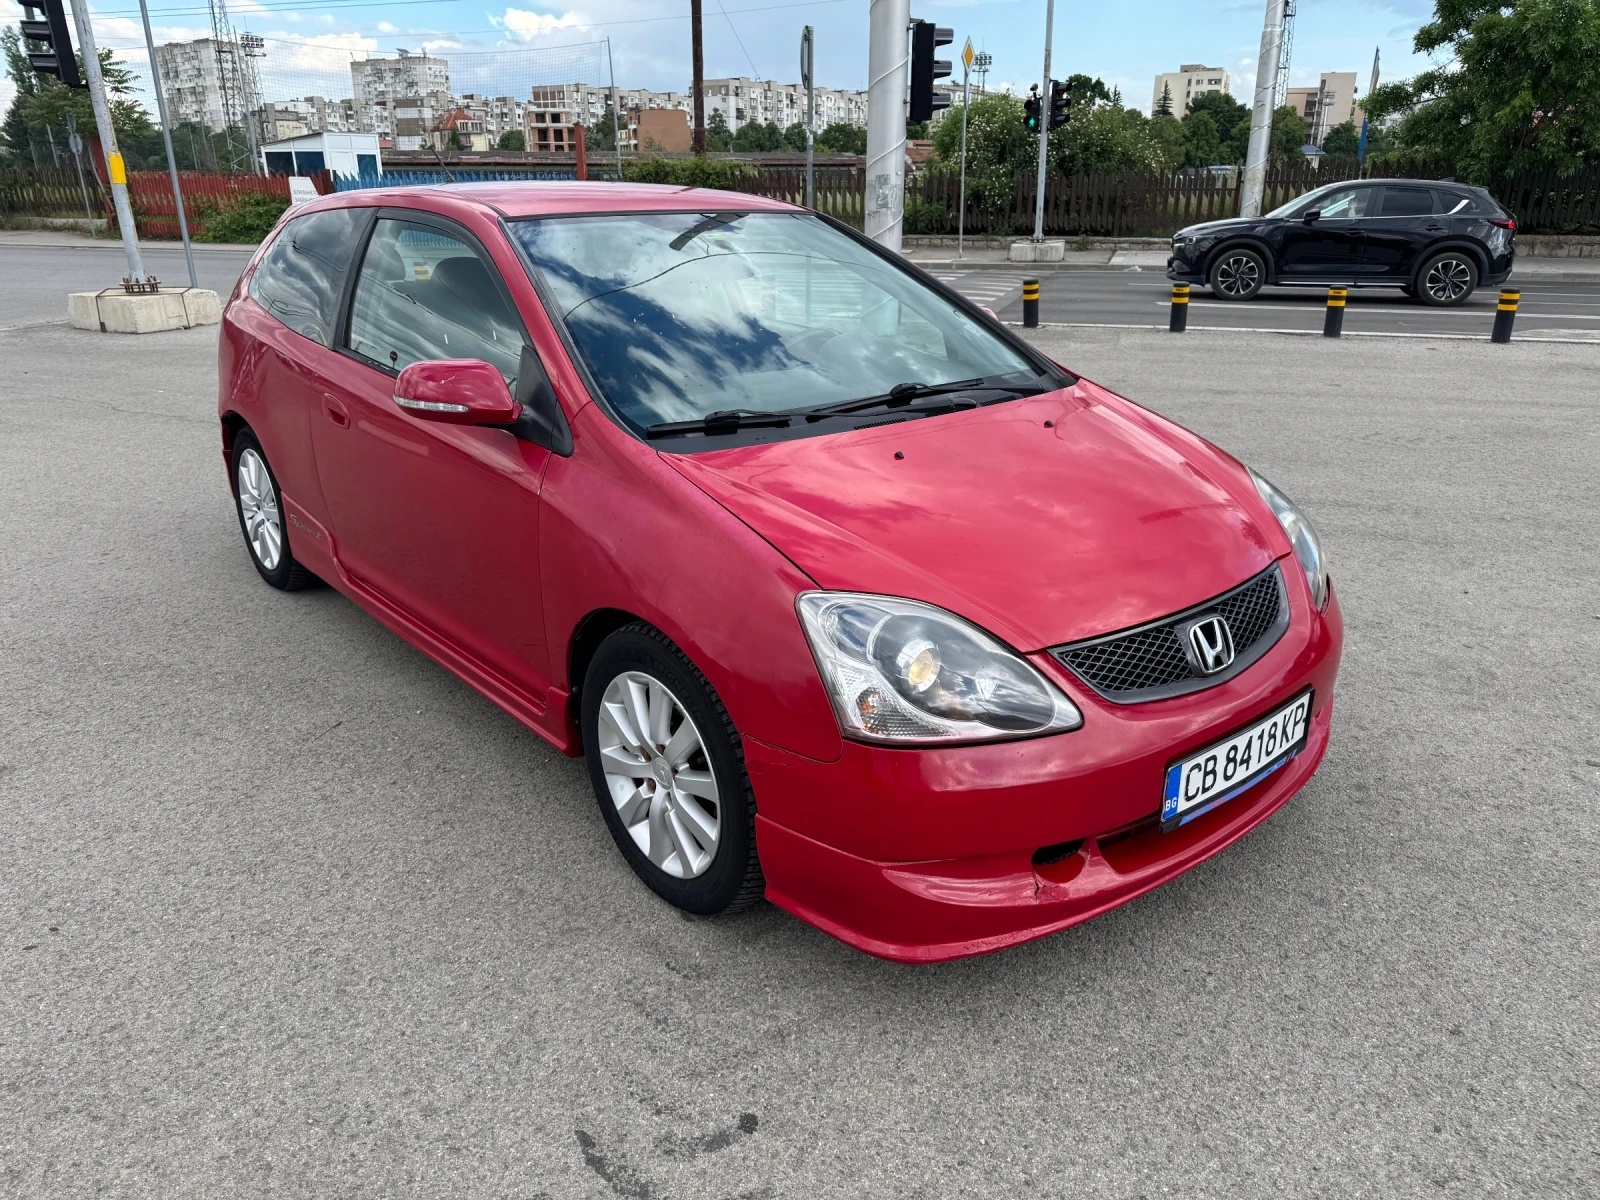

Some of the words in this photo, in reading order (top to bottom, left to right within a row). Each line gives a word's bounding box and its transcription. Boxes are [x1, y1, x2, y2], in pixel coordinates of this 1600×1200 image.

[289, 513, 322, 539] Sport
[1184, 754, 1218, 802] CB
[1223, 721, 1278, 782] 8418
[1279, 702, 1306, 750] KP
[1165, 797, 1177, 811] BG
